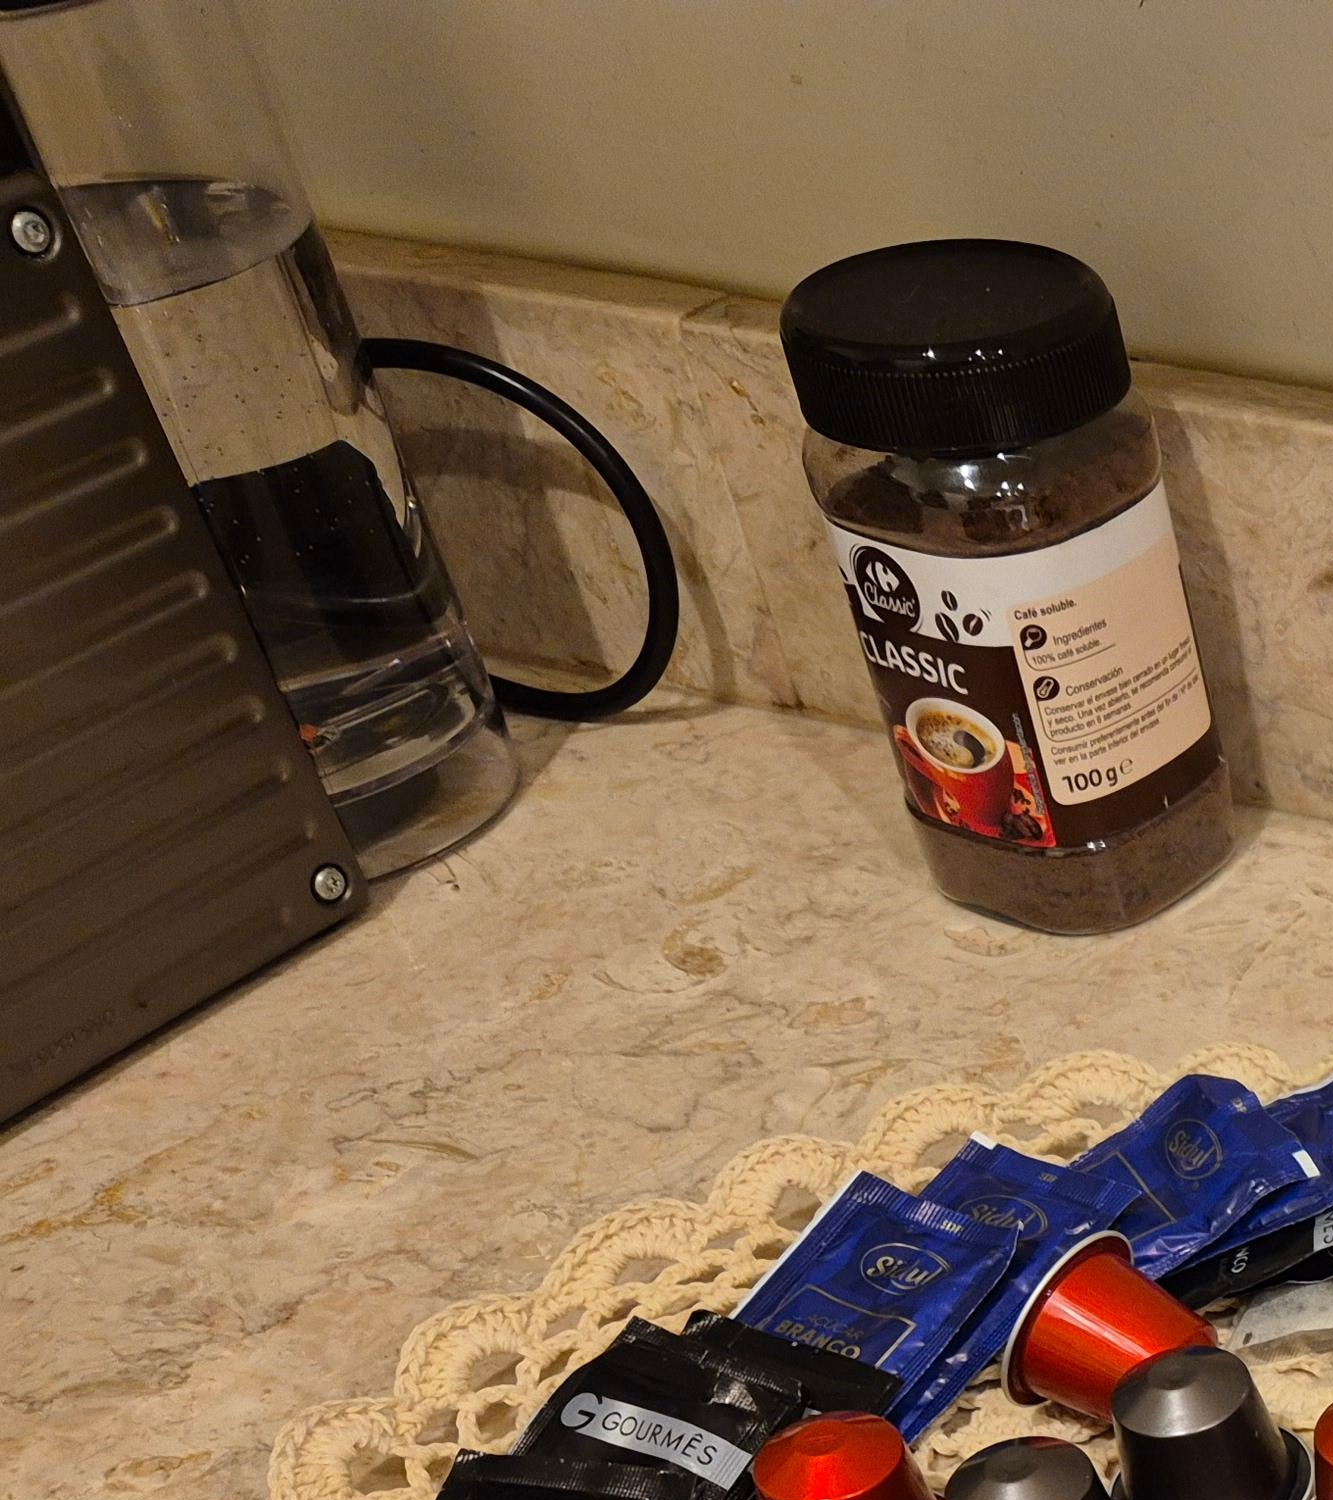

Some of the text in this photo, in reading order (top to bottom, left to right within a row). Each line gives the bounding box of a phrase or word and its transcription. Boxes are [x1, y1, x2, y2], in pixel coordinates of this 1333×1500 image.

[864, 581, 915, 618] Classic
[1014, 599, 1077, 620] Café soluble.
[1053, 619, 1107, 646] Ingredientes
[860, 630, 968, 695] CLASSIC
[1032, 653, 1056, 665] 100%
[1057, 648, 1074, 660] café
[1066, 665, 1123, 696] Conservación
[1062, 768, 1102, 793] 100
[1105, 766, 1118, 787] g
[866, 1255, 943, 1290] Sidul
[774, 1319, 861, 1360] BRANCO
[601, 1409, 718, 1466] GOURMÊS
